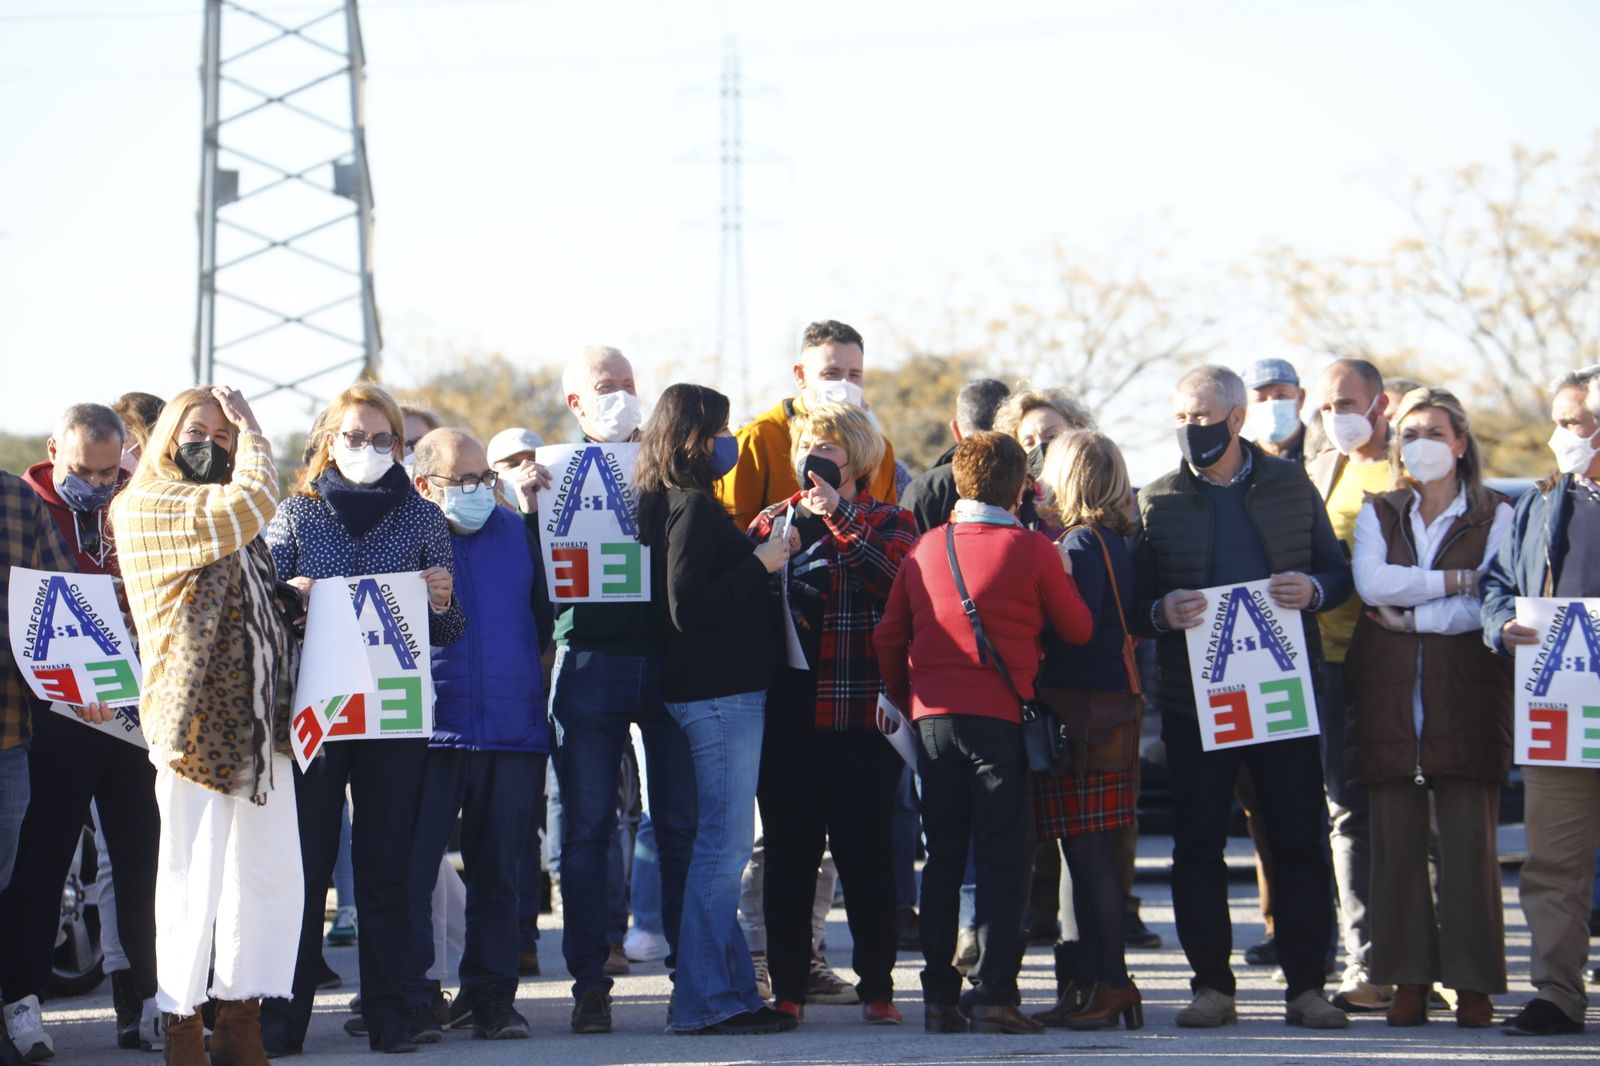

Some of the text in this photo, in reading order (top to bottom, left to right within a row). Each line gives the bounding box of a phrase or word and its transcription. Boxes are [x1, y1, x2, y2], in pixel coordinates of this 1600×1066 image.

[547, 449, 584, 533] PLATAFORMA
[23, 578, 50, 658] PLATAFORMA
[69, 583, 122, 648] CIUDADANA
[380, 583, 422, 660] CIUDADANA
[1201, 592, 1231, 680] PLATAFORMA
[1252, 590, 1298, 661] CIUDADANA
[1524, 604, 1569, 693] PLATAFORMA
